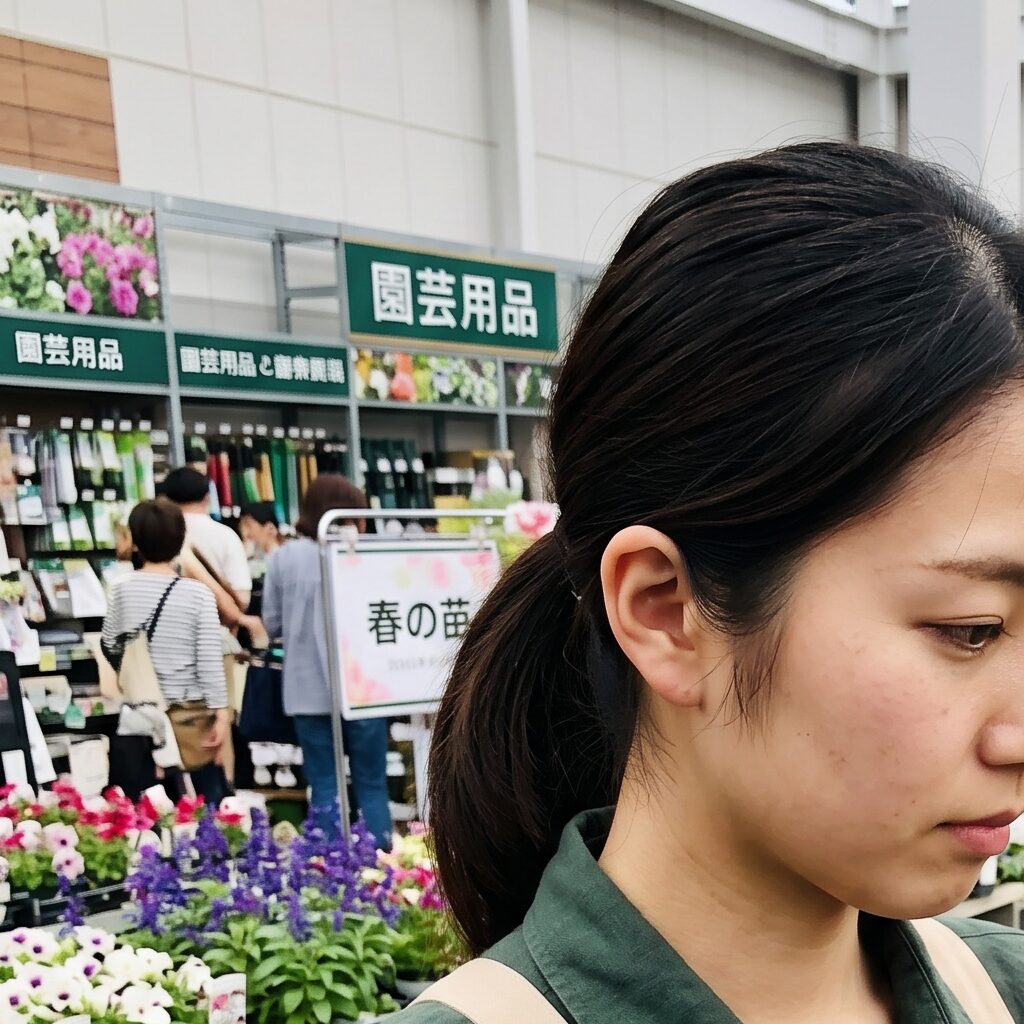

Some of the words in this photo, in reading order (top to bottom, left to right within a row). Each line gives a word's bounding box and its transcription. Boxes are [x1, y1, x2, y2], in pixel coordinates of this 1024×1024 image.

[371, 261, 538, 338] 園芸用品
[15, 330, 124, 371] 園芸用品
[368, 598, 469, 644] 春の苗
